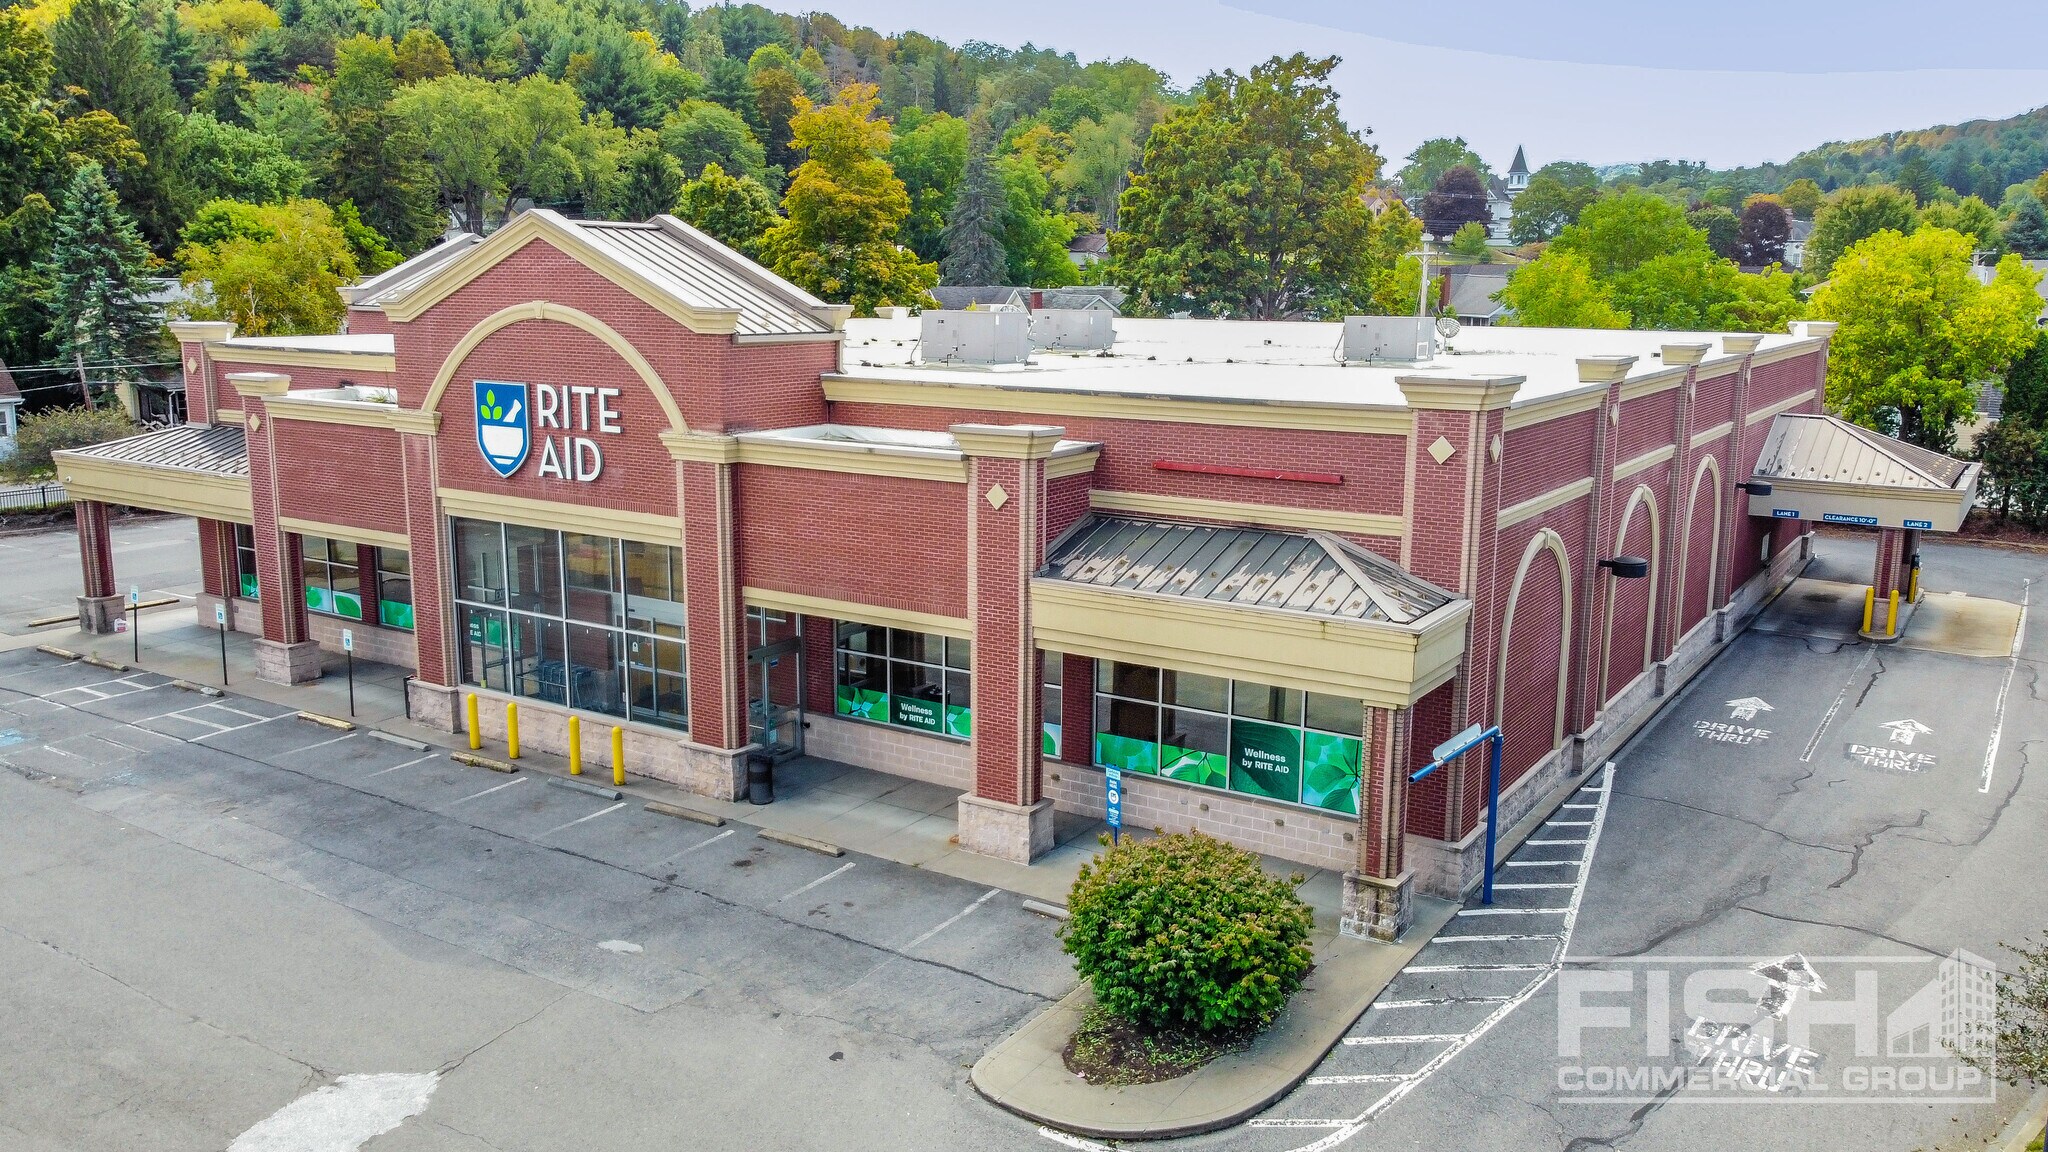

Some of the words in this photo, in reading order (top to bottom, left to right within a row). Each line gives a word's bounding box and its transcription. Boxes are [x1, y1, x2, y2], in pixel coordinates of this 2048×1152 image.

[536, 383, 623, 434] RITE
[538, 435, 604, 482] AID
[1824, 515, 1858, 523] CLEARANCE
[900, 702, 933, 716] Wellness
[899, 712, 908, 721] by
[909, 713, 923, 723] RITE
[924, 717, 936, 725] AID
[1693, 720, 1773, 739] DRIVE
[1699, 729, 1752, 744] THRU
[1244, 747, 1286, 763] Wellness
[1851, 744, 1936, 765] DRIVE
[1242, 758, 1253, 768] by
[1254, 760, 1273, 771] RITE
[1274, 764, 1289, 774] AID
[1861, 755, 1920, 772] THRU
[1687, 1016, 1819, 1075] DRIVE
[1689, 1042, 1788, 1092] THRU
